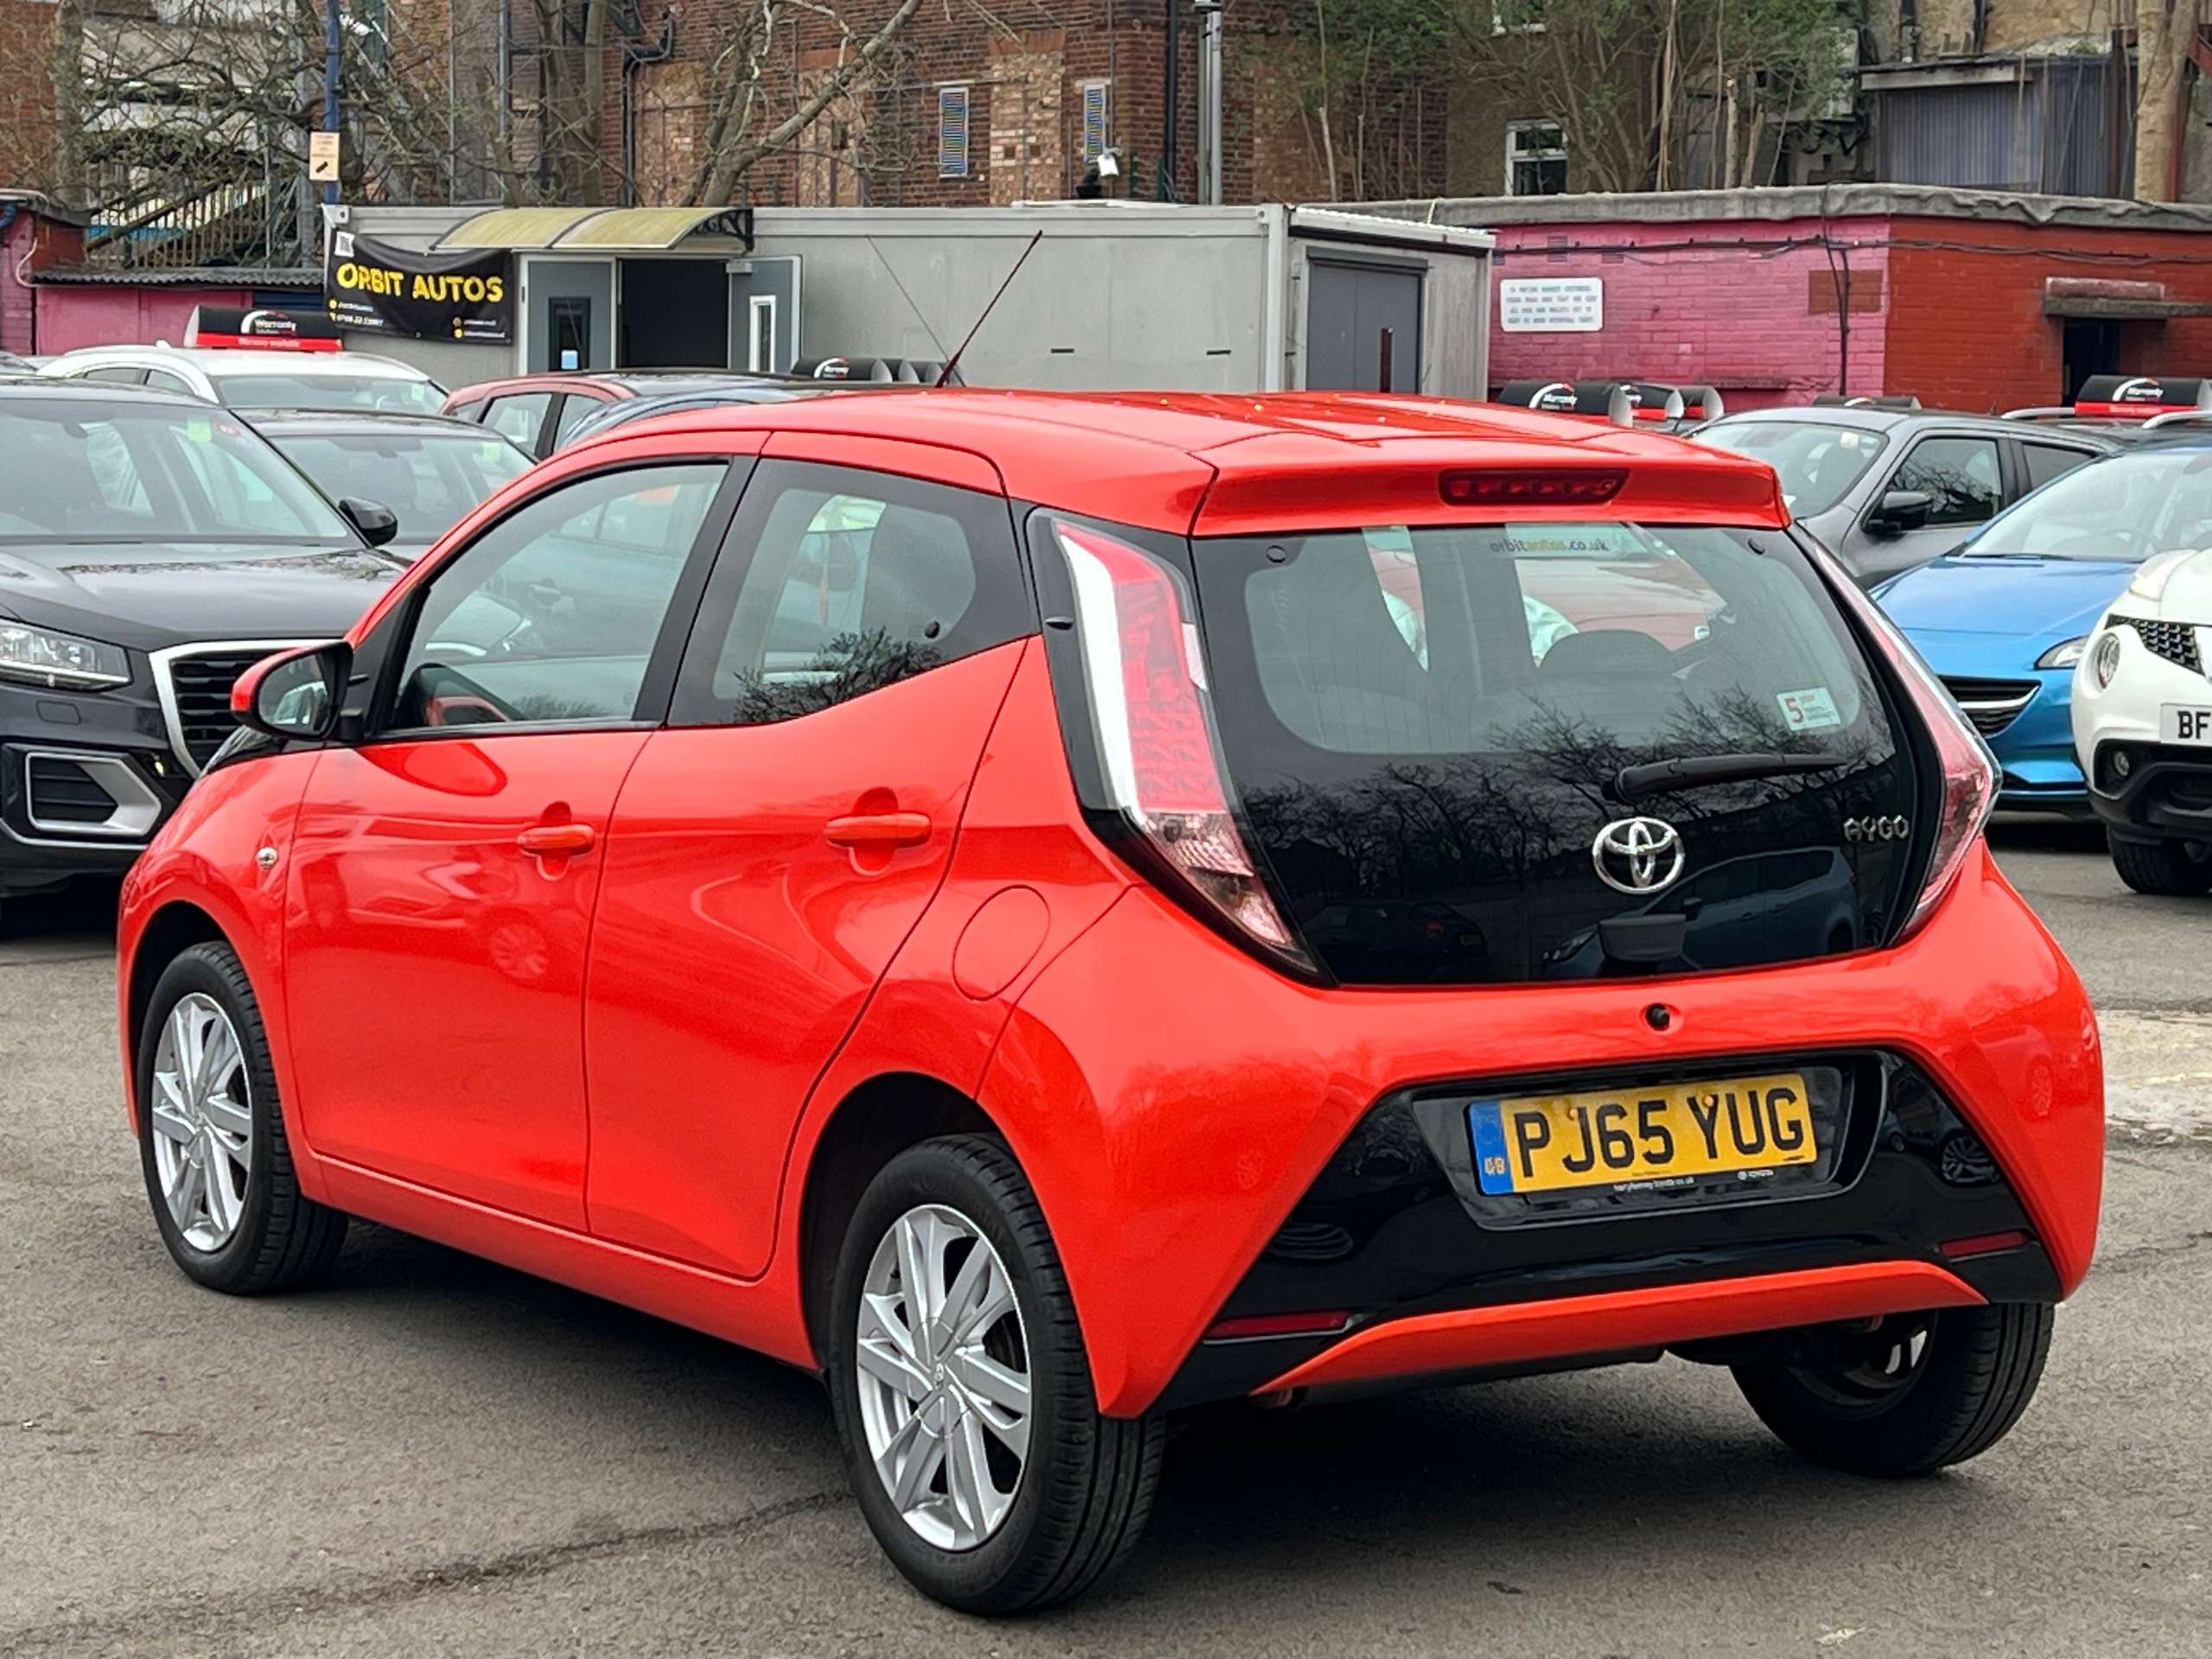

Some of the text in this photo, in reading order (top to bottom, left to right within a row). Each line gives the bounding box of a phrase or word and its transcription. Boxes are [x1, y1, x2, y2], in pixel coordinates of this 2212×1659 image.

[336, 263, 504, 302] ORBIT AUTOS
[1784, 696, 1804, 724] 5
[2177, 710, 2211, 740] BF
[1843, 815, 1910, 842] AYGO
[1512, 1087, 1805, 1179] PJ65 YUG
